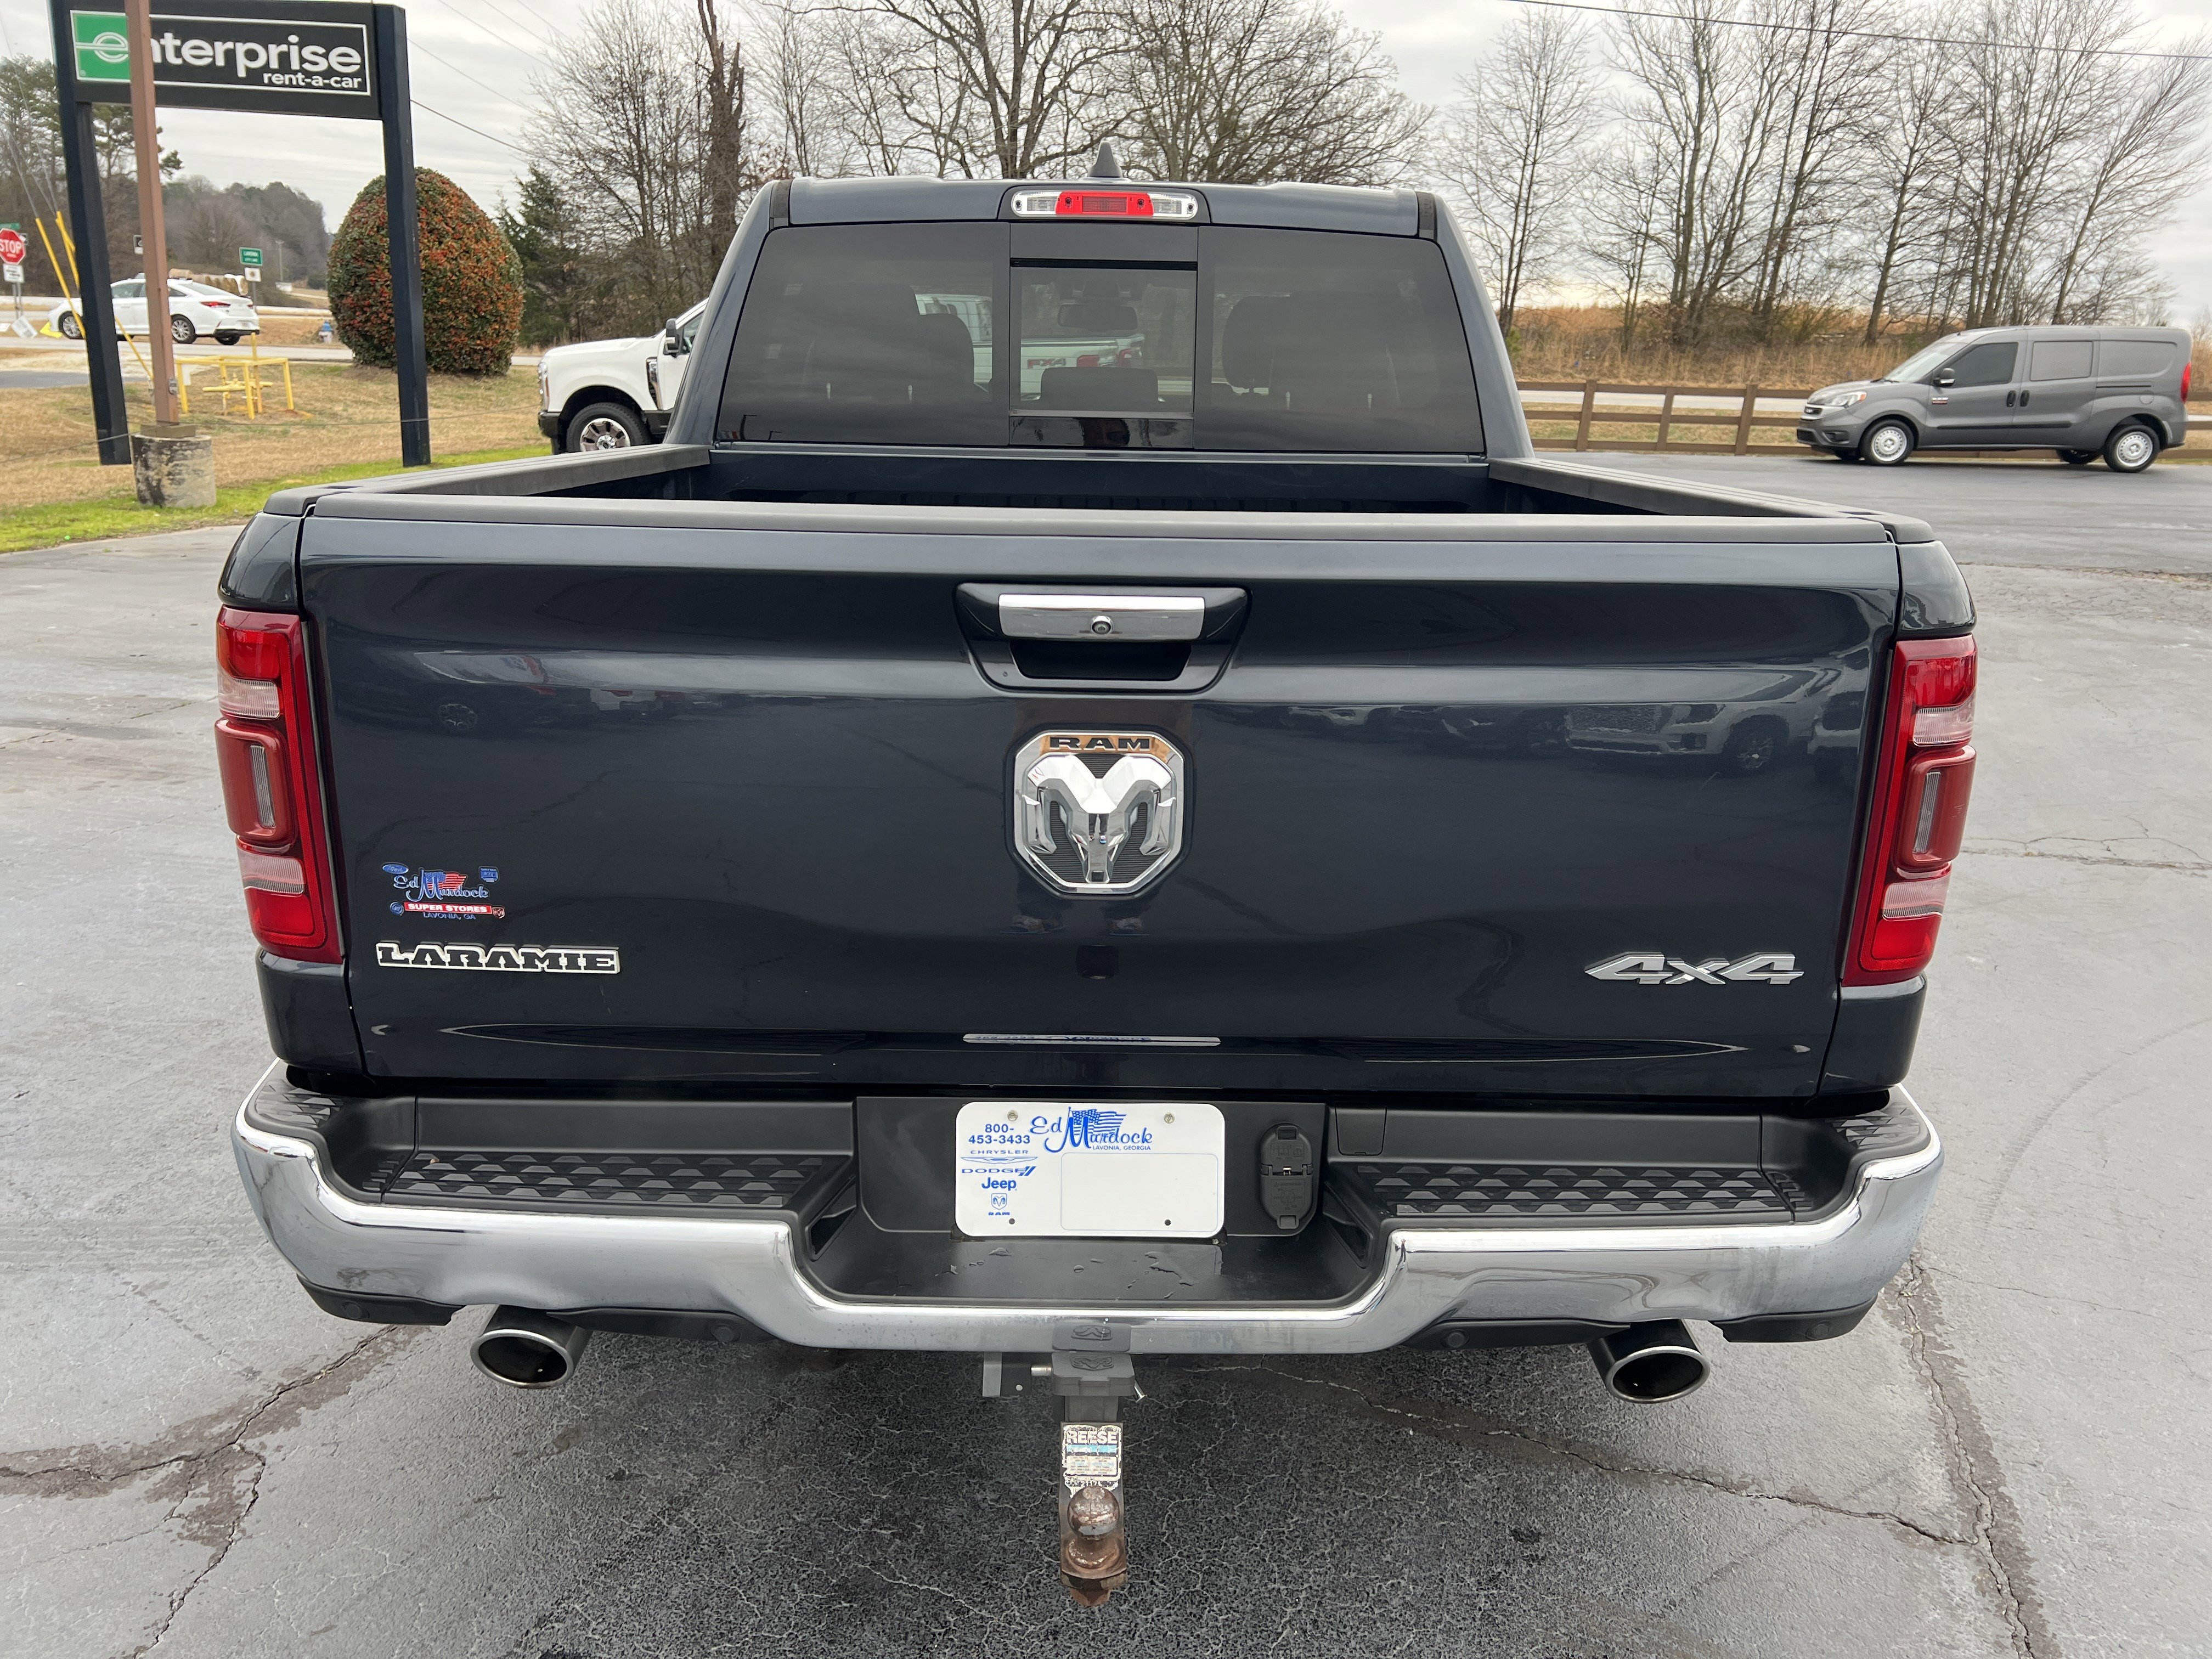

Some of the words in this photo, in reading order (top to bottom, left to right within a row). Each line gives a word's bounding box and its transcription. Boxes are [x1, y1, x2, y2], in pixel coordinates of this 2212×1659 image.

[263, 72, 362, 88] rent-a-car
[0, 239, 22, 255] STOP
[1027, 358, 1066, 369] FX4
[1049, 737, 1151, 751] RAM
[394, 875, 419, 889] Ed
[406, 869, 489, 902] Murdock
[408, 902, 443, 911] SUPER
[445, 904, 488, 913] STORES
[376, 940, 621, 974] LARAMIE
[985, 1124, 1014, 1133] 800-
[1029, 1115, 1062, 1135] Ed
[1044, 1107, 1153, 1153] Murdock
[968, 1135, 1030, 1144] 453-3433
[981, 1177, 1017, 1191] Jeep
[1066, 1430, 1118, 1444] REESE
